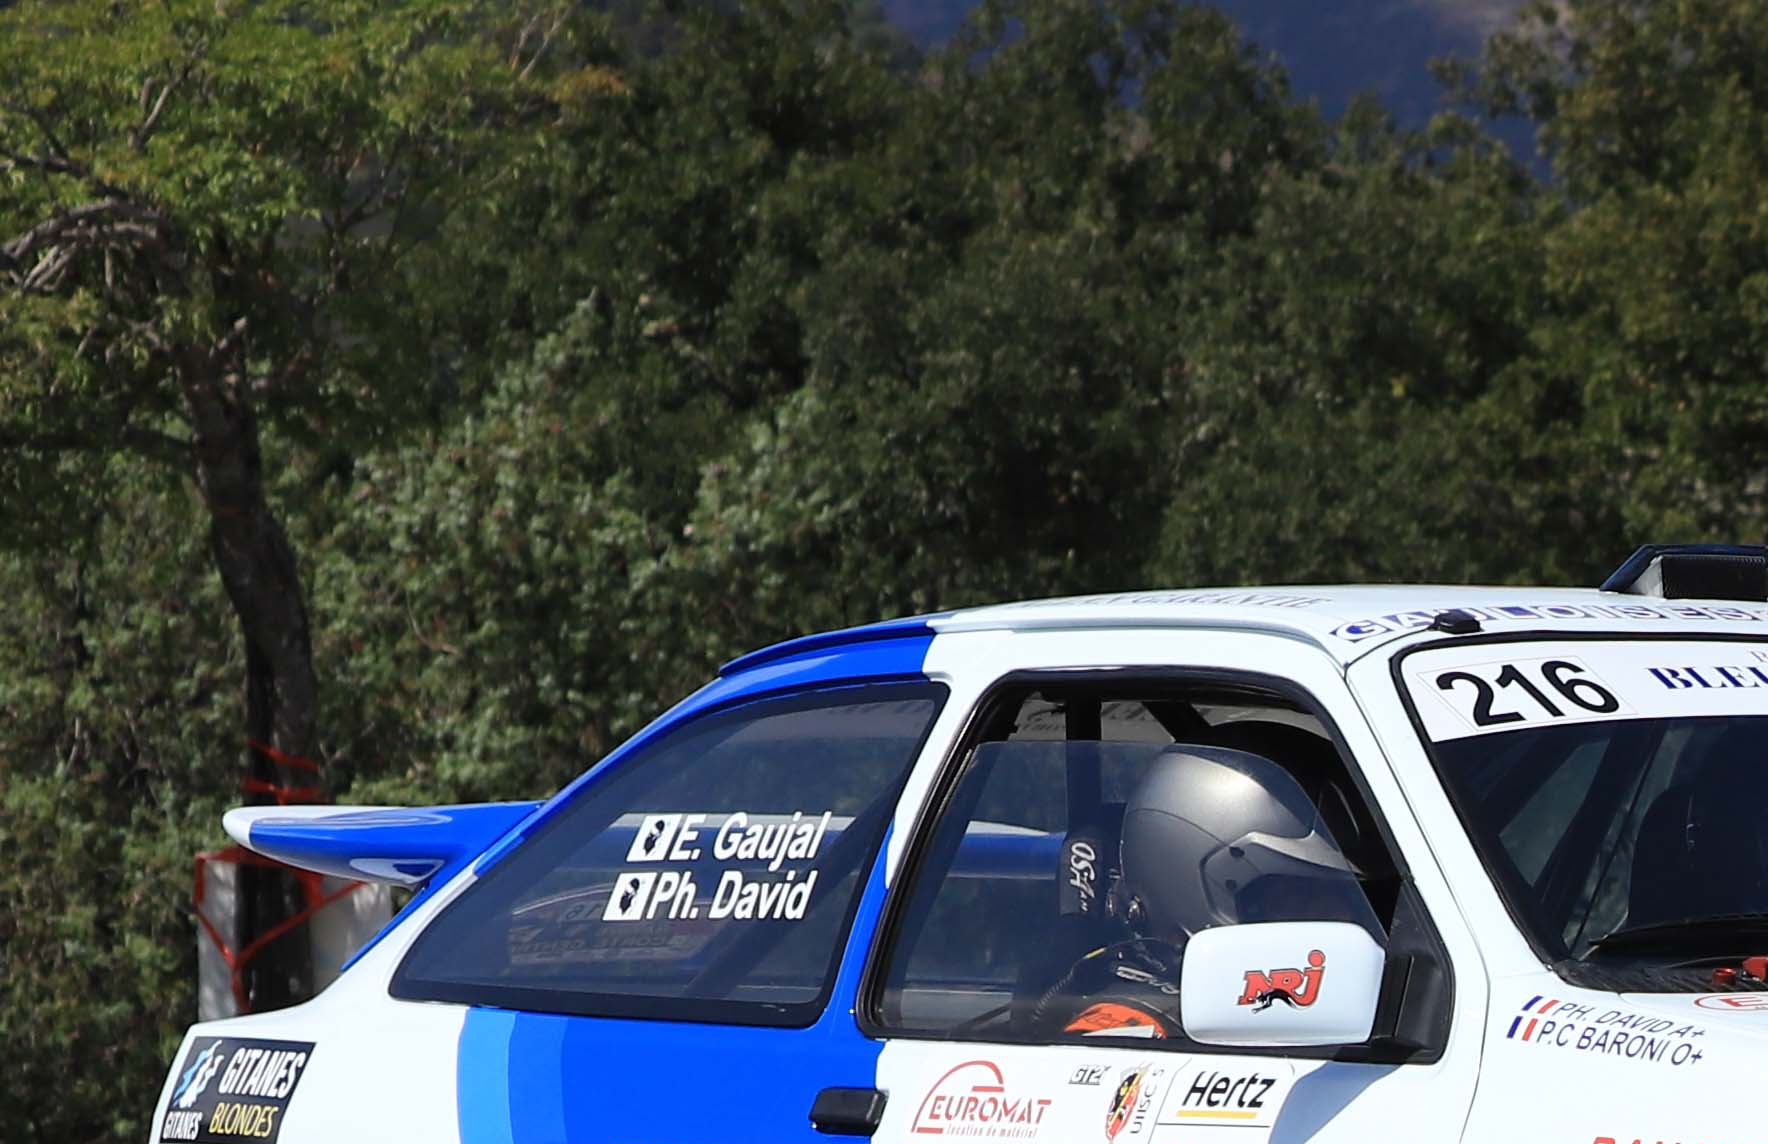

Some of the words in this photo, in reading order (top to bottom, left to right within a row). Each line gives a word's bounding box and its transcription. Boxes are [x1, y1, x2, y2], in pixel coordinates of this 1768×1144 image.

[1436, 660, 1620, 727] 216
[668, 813, 705, 861] E.
[713, 811, 832, 872] Gaujal
[645, 871, 699, 920] Ph.
[708, 869, 818, 920] David
[1551, 1002, 1588, 1021] PH.
[1595, 1010, 1675, 1036] DAVID
[1669, 1025, 1707, 1039] A+
[1536, 1021, 1571, 1046] P.C
[1576, 1026, 1671, 1063] BARONI
[218, 1047, 307, 1099] GITANES
[1181, 1069, 1278, 1109] Hertz
[162, 1110, 202, 1141] GITANES
[209, 1101, 279, 1138] BLONDES
[927, 1095, 1052, 1126] EUROMAT
